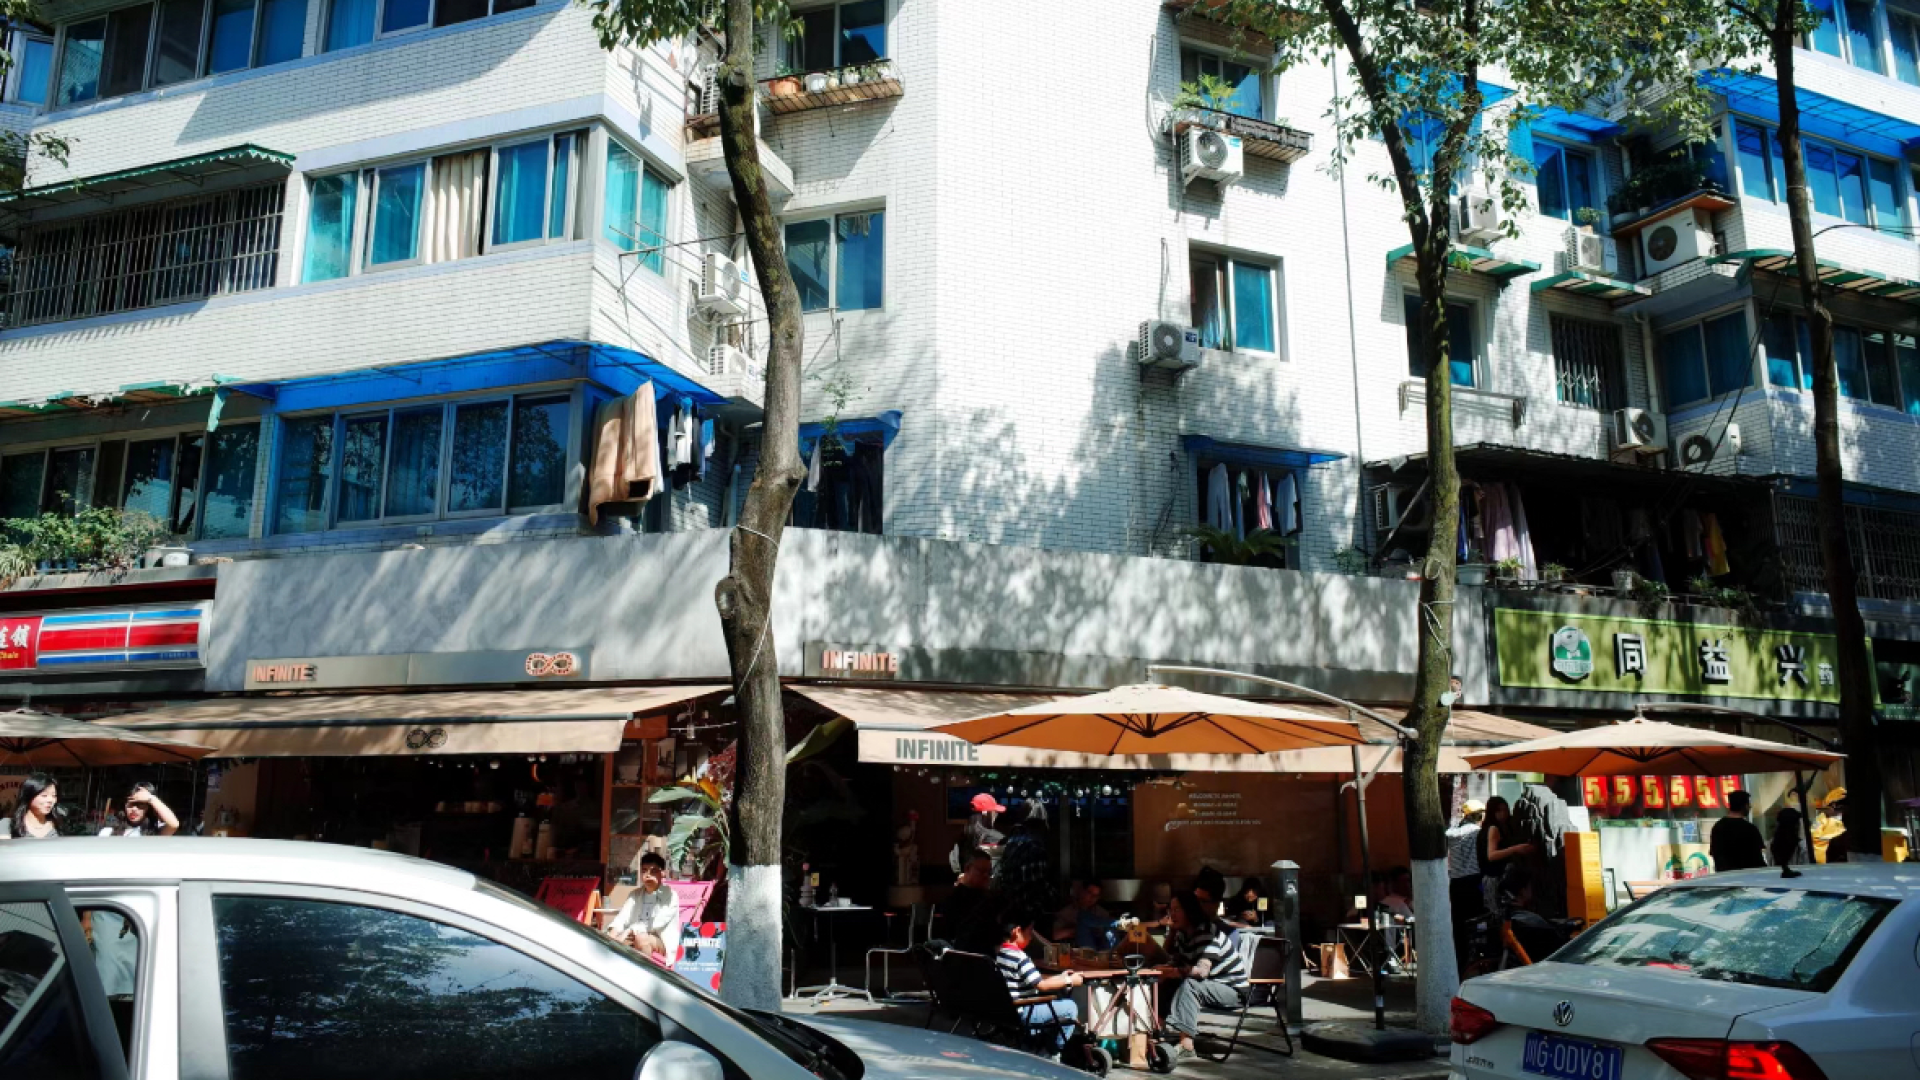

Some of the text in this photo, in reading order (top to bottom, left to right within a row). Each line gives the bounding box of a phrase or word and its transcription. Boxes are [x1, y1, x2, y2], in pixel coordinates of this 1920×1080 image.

[823, 650, 898, 672] INFINITE
[253, 663, 310, 683] INFINITE
[895, 737, 980, 762] INFINITE
